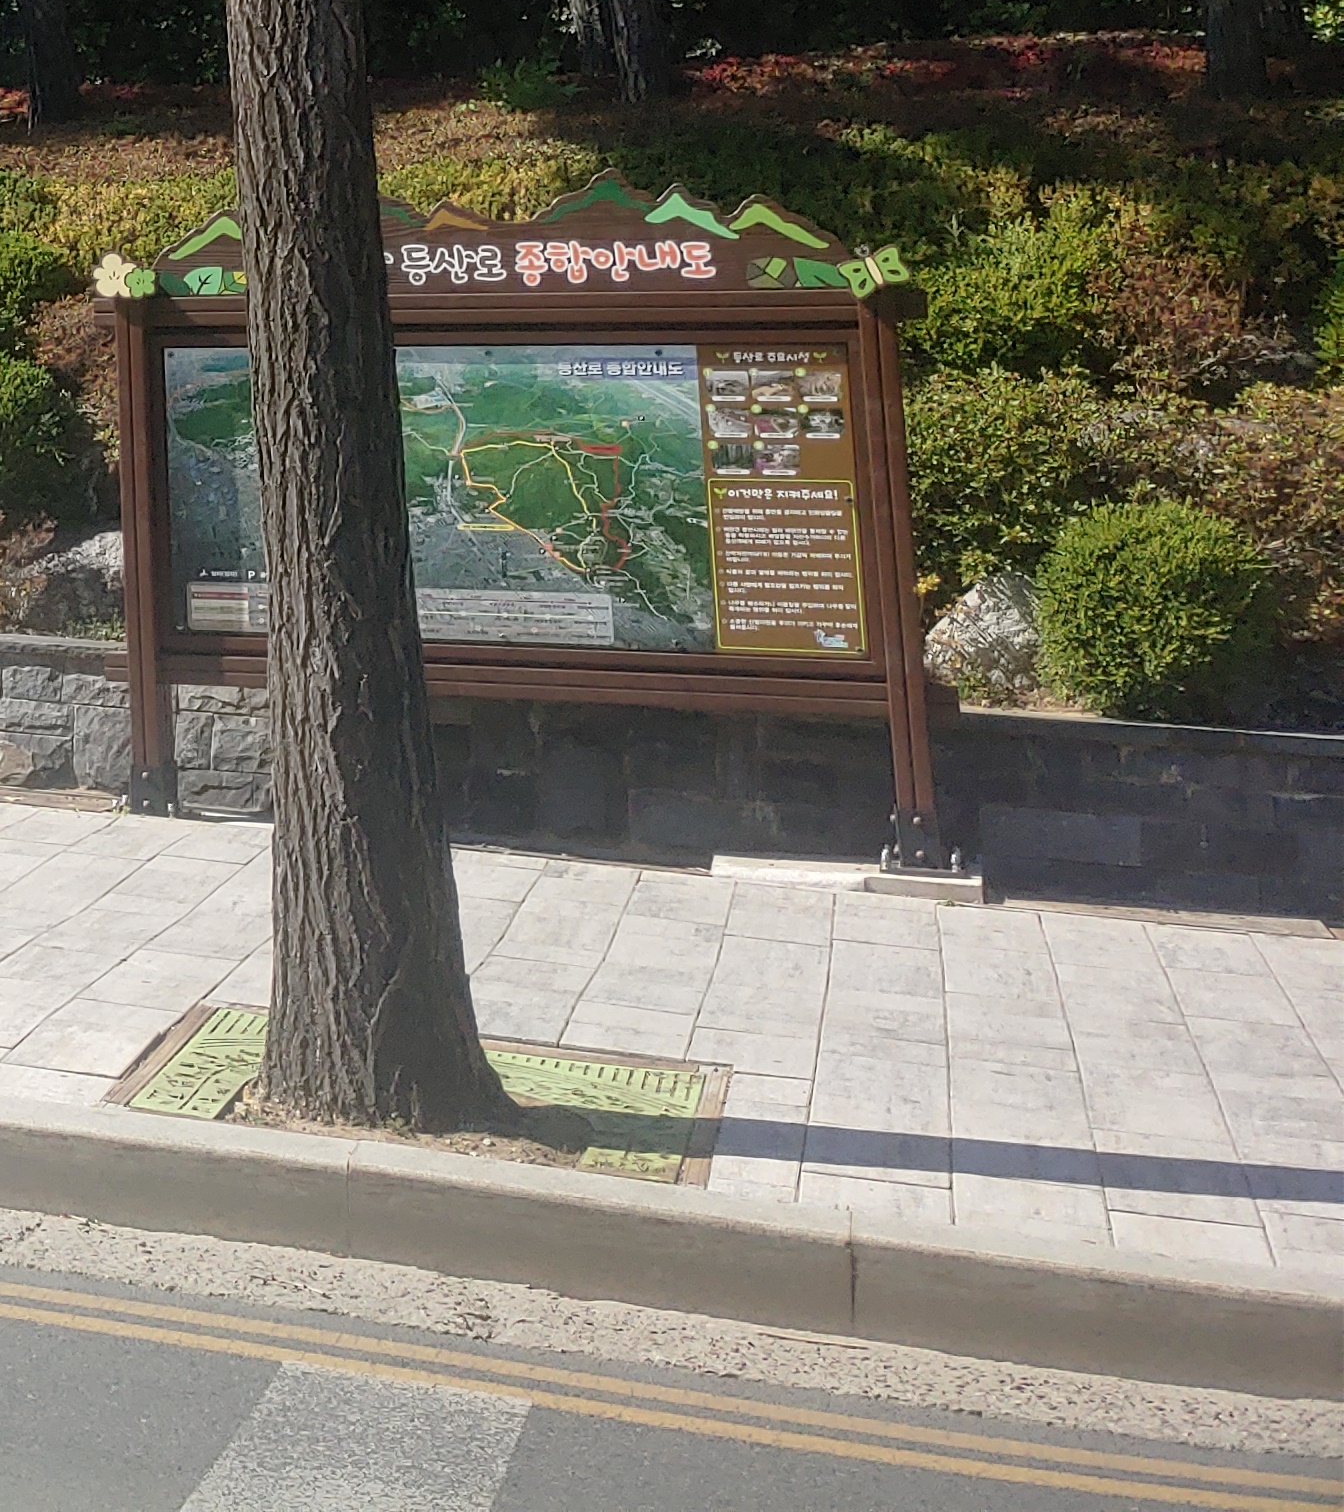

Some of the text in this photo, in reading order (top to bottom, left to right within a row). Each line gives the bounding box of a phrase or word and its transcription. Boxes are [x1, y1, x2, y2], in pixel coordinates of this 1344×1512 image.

[401, 240, 716, 286] 등산로 종합안내도
[733, 351, 764, 364] 등산로
[558, 361, 684, 377] 등산로 종합안내도
[248, 570, 256, 579] P
